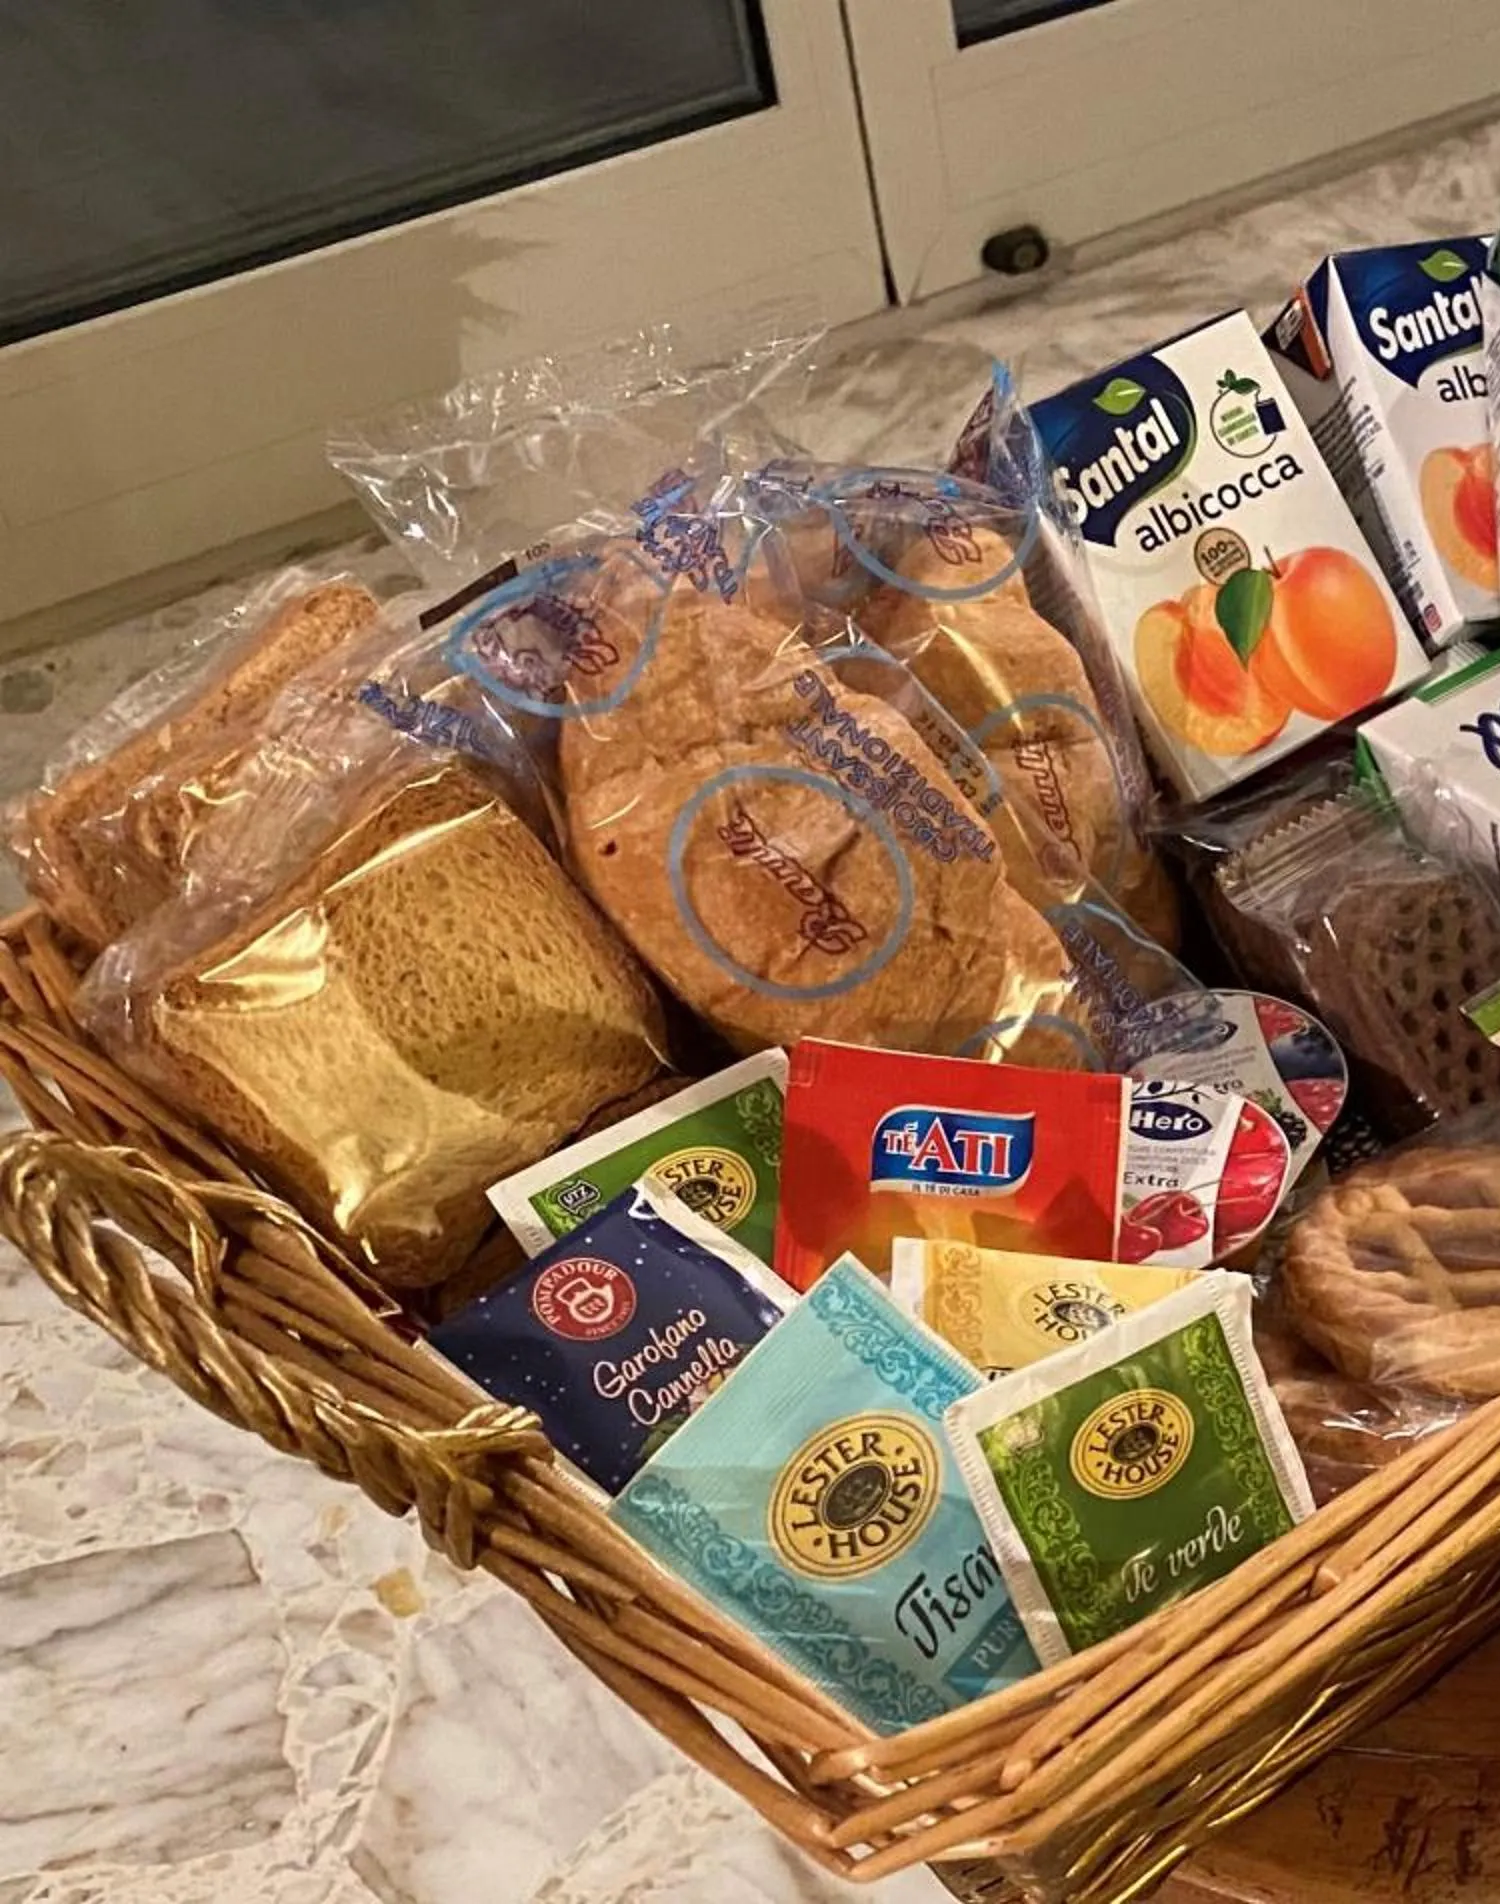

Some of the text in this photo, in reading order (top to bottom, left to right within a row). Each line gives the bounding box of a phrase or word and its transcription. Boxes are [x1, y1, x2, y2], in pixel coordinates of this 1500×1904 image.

[1369, 272, 1484, 360] Santa
[1052, 397, 1180, 525] Santal
[1135, 453, 1303, 552] albicocca
[792, 668, 997, 864] TRADIZIONALE
[716, 798, 870, 957] Bauli
[1130, 1109, 1204, 1131] Hero
[1213, 1078, 1245, 1095] tra
[658, 1158, 723, 1186] STER
[908, 1116, 1014, 1179] ATI
[1123, 1171, 1179, 1188] Extra
[702, 1185, 742, 1223] USE
[539, 1261, 618, 1325] POMPADOUR
[1033, 1283, 1126, 1320] LESTER
[593, 1308, 707, 1399] Garofano
[628, 1337, 740, 1425] Cannella
[1089, 1402, 1168, 1454] LESTER
[1102, 1432, 1179, 1485] HOUSE
[791, 1431, 886, 1532] LESTER
[827, 1457, 923, 1559] HOUSE
[1167, 1505, 1245, 1577] verde
